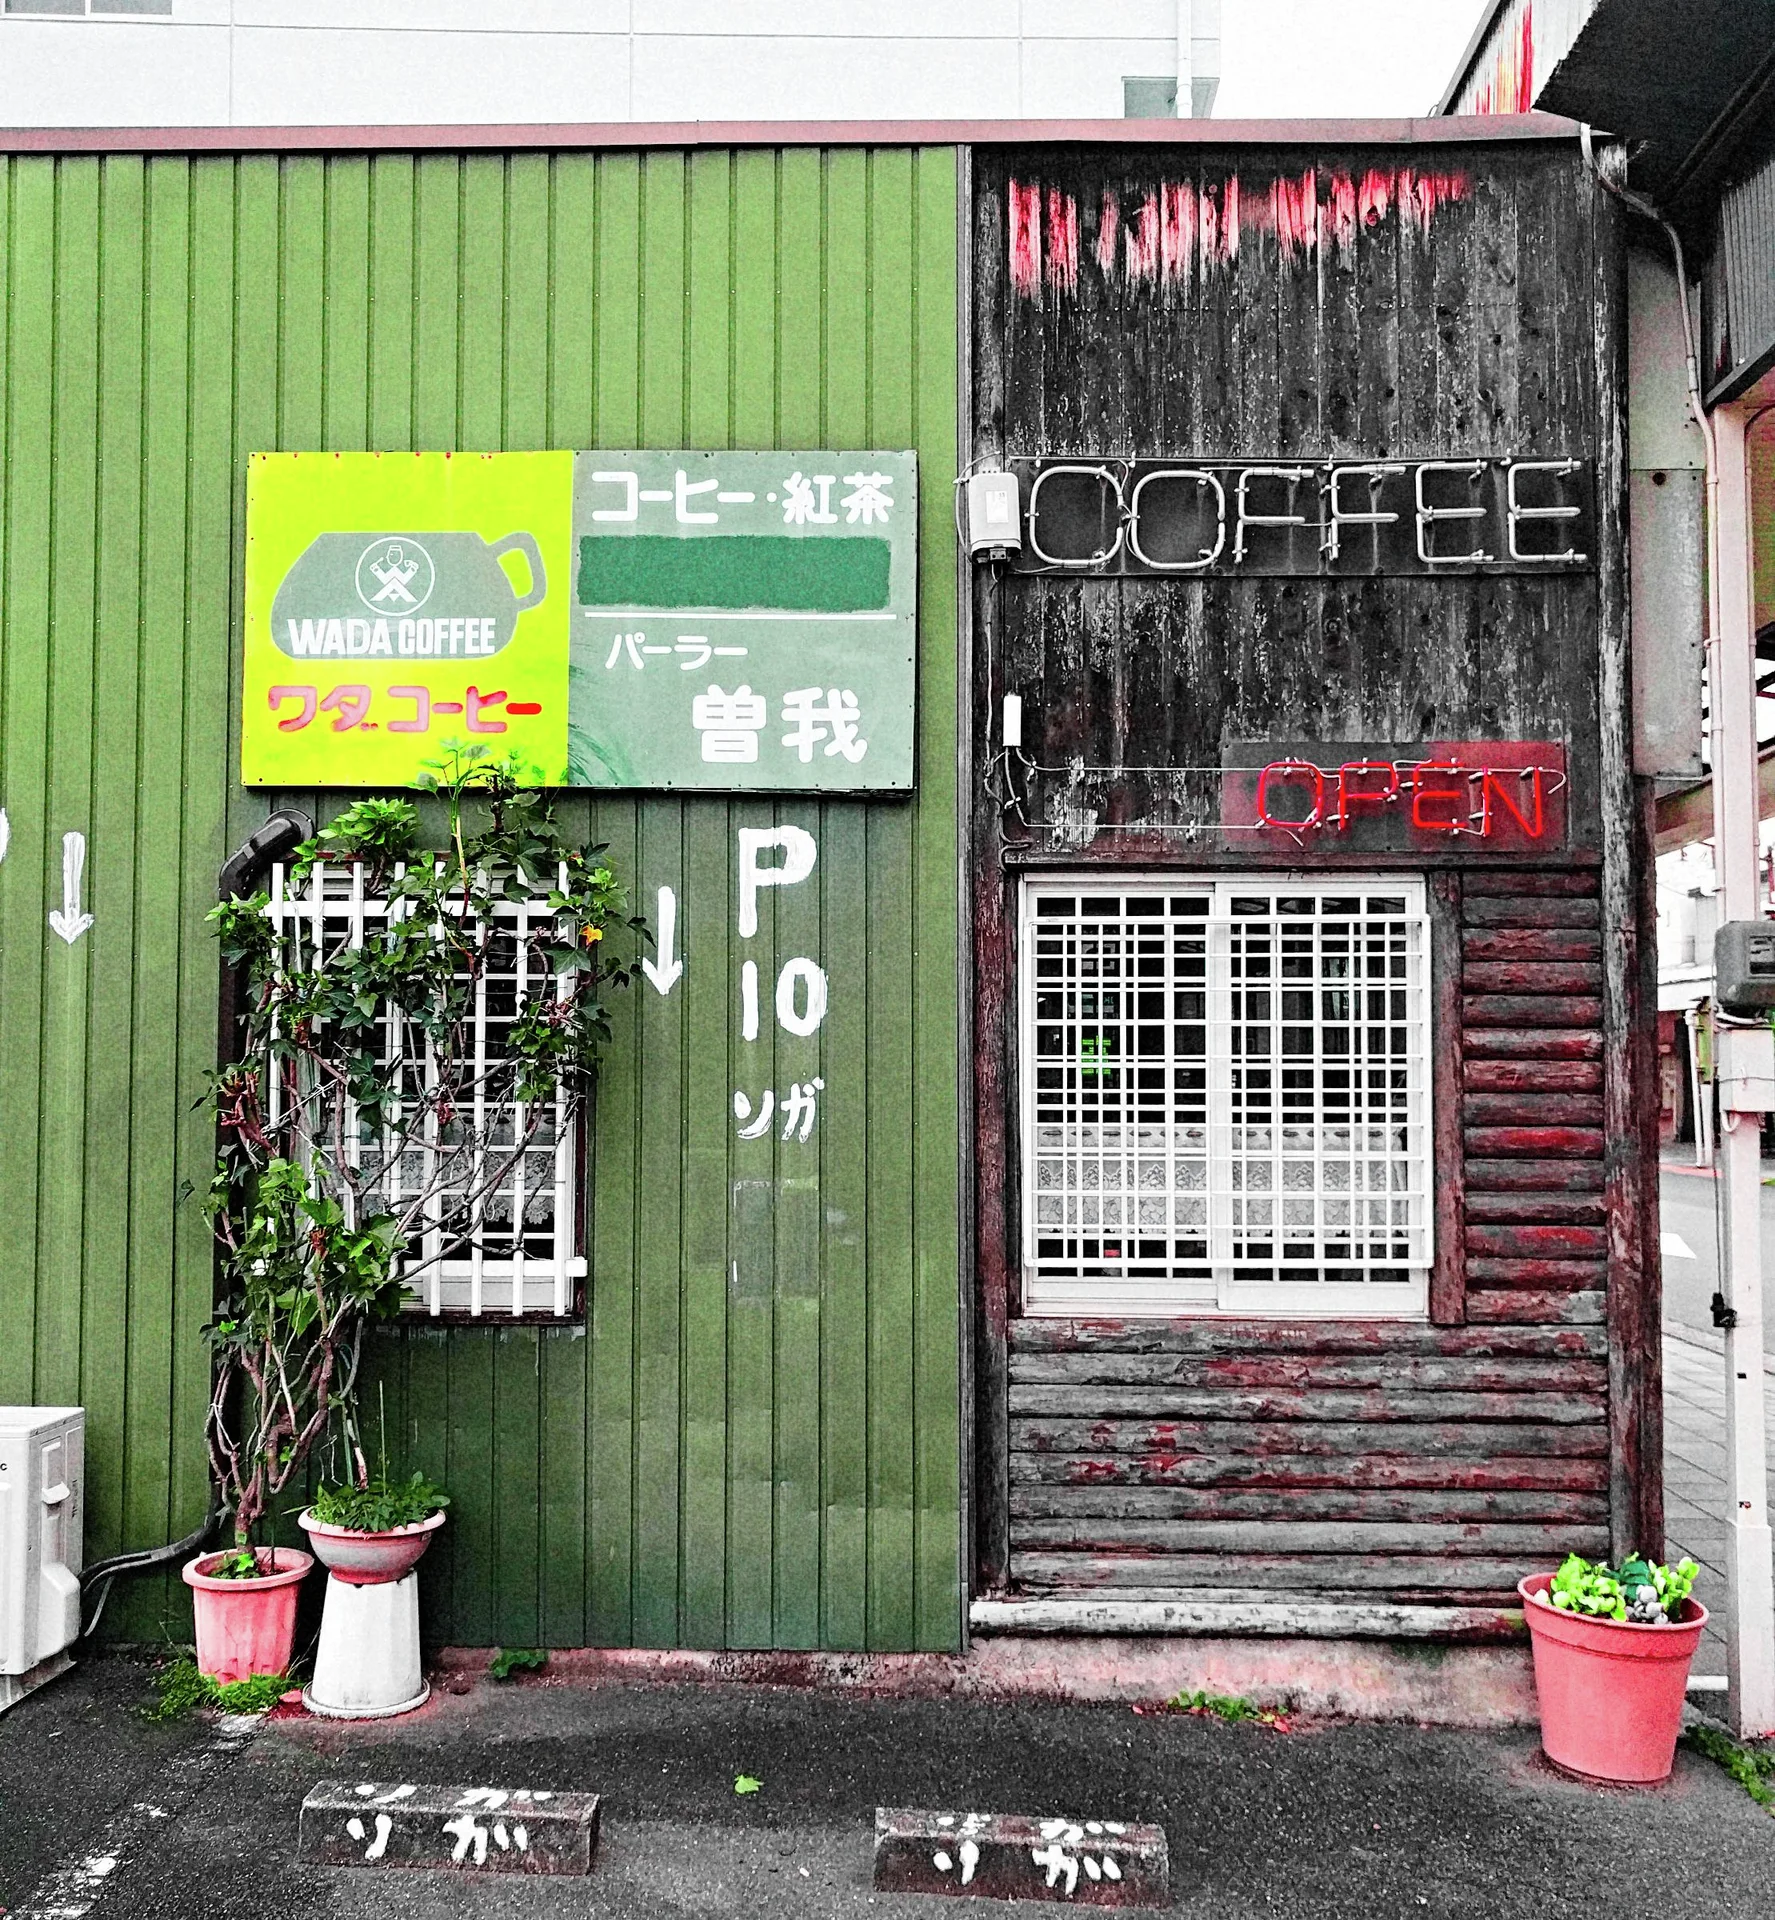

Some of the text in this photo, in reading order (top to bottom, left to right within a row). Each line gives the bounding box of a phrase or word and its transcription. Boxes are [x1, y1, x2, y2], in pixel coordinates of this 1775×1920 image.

[1030, 461, 1588, 571] COFFEE
[287, 617, 496, 655] WADA COFFEE
[605, 633, 749, 671] パーラー
[692, 684, 869, 763] 曽我
[1258, 761, 1542, 838] OPEN
[738, 825, 817, 938] P
